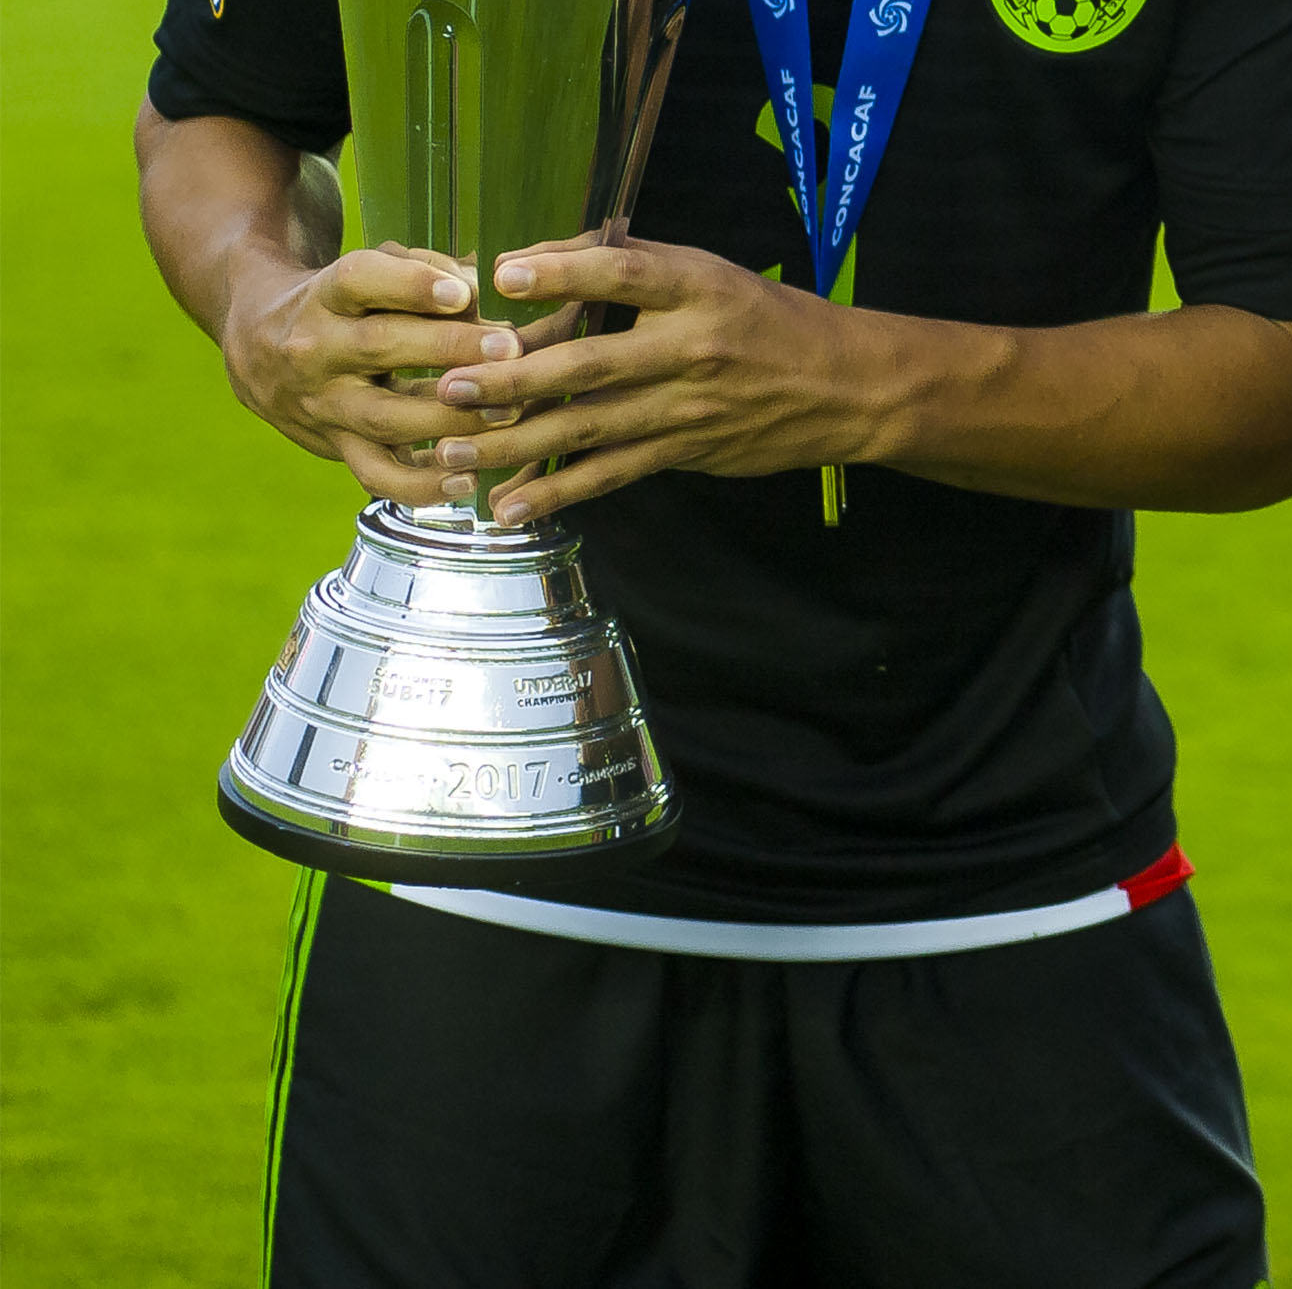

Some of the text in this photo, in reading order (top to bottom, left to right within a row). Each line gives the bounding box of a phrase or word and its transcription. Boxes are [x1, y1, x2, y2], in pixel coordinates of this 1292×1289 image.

[781, 69, 811, 235] CONCACAF
[832, 84, 876, 248] CONCACAF
[517, 690, 593, 708] CHAMPIONS
[447, 760, 552, 801] 2017
